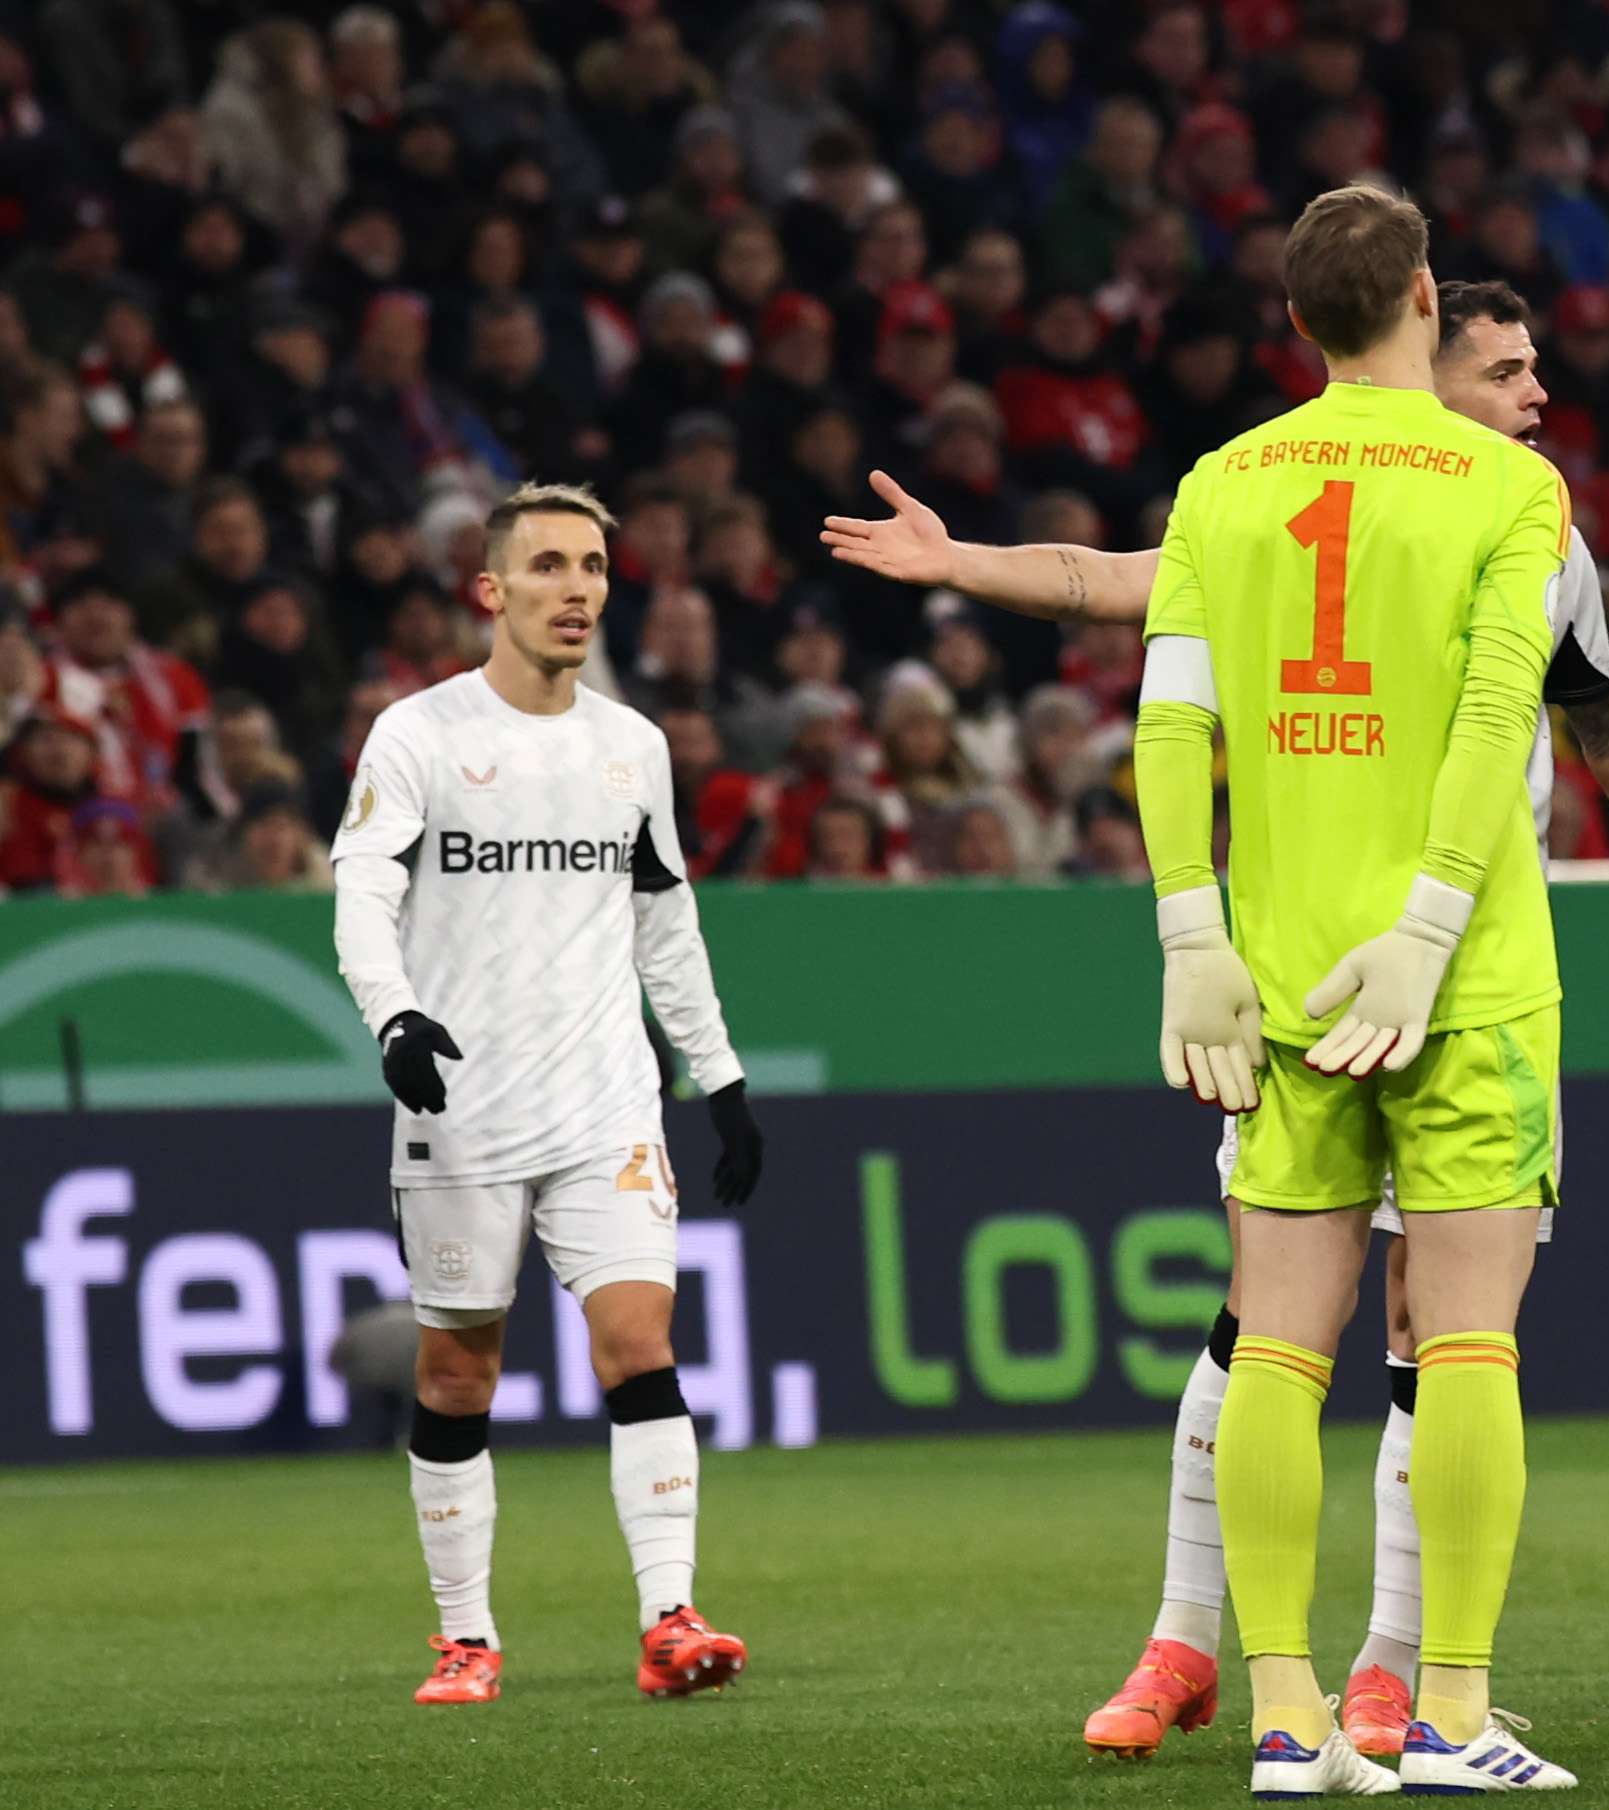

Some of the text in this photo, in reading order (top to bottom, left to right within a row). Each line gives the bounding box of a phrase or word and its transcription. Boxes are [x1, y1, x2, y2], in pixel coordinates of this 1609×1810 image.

[1224, 441, 1474, 478] FC BAYERN MÜNCHEN
[1280, 480, 1372, 696] 1
[1267, 712, 1385, 757] NEUER
[857, 1150, 1233, 1408] los
